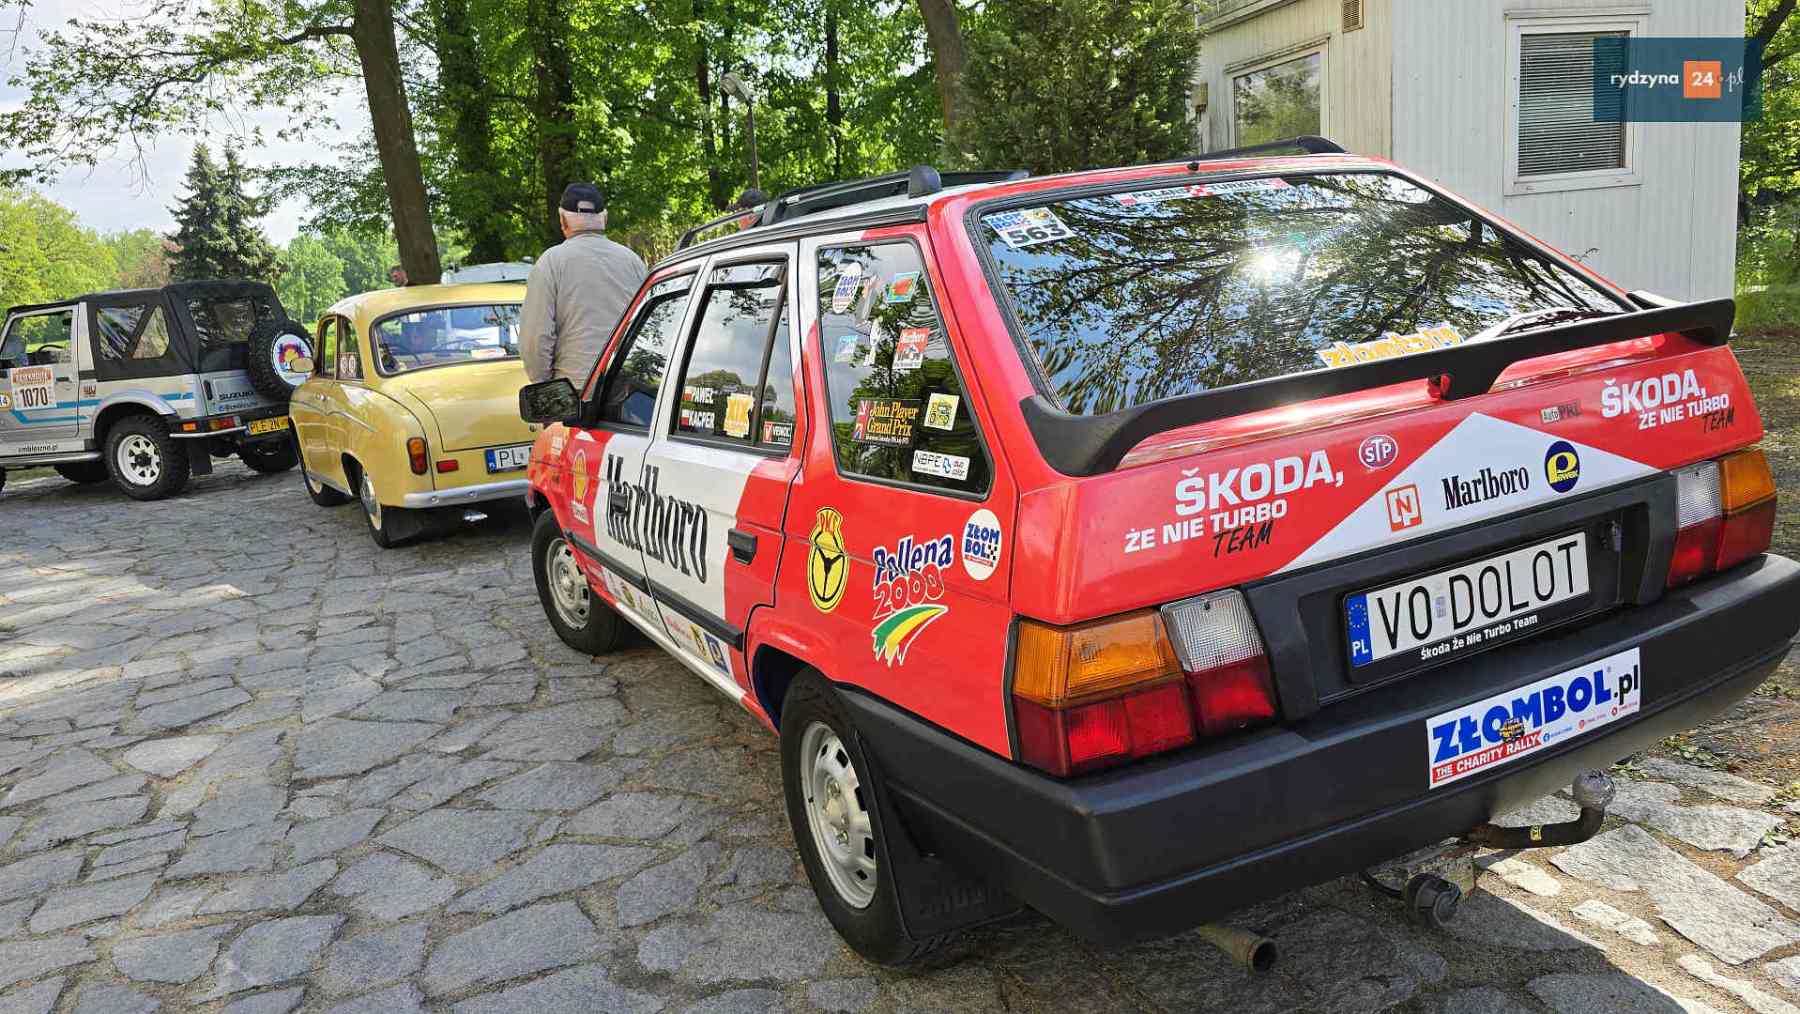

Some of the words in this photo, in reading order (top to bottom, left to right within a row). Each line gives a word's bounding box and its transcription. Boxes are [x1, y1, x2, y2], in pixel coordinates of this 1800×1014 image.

[1007, 224, 1066, 244] 563
[19, 386, 48, 408] 1070
[869, 399, 891, 418] John
[892, 400, 919, 420] Player
[1602, 369, 1706, 418] ŠKODA,
[1660, 404, 1684, 425] NIE
[1686, 393, 1729, 417] TURBO
[688, 410, 716, 429] KACPER
[866, 417, 892, 434] Grand
[893, 418, 913, 437] Prix
[1702, 406, 1735, 433] TEAM
[1364, 437, 1393, 465] STP
[1175, 449, 1344, 517] ŠKODA,
[1441, 466, 1530, 511] Marlboro
[606, 453, 708, 584] Marlboro
[966, 523, 1000, 545] ZŁOM
[1162, 516, 1204, 545] NIE
[1209, 498, 1288, 533] TURBO
[1212, 520, 1275, 559] TEAM
[873, 534, 954, 587] Pollena
[872, 563, 945, 620] 2000
[1448, 540, 1578, 630] DOLOT
[1466, 631, 1482, 645] Nie
[1483, 621, 1511, 640] Turbo
[1513, 613, 1538, 630] Team
[1352, 641, 1369, 657] PL
[1435, 764, 1453, 779] THE
[1456, 748, 1503, 773] CHARITY
[1506, 734, 1538, 756] RALLY
